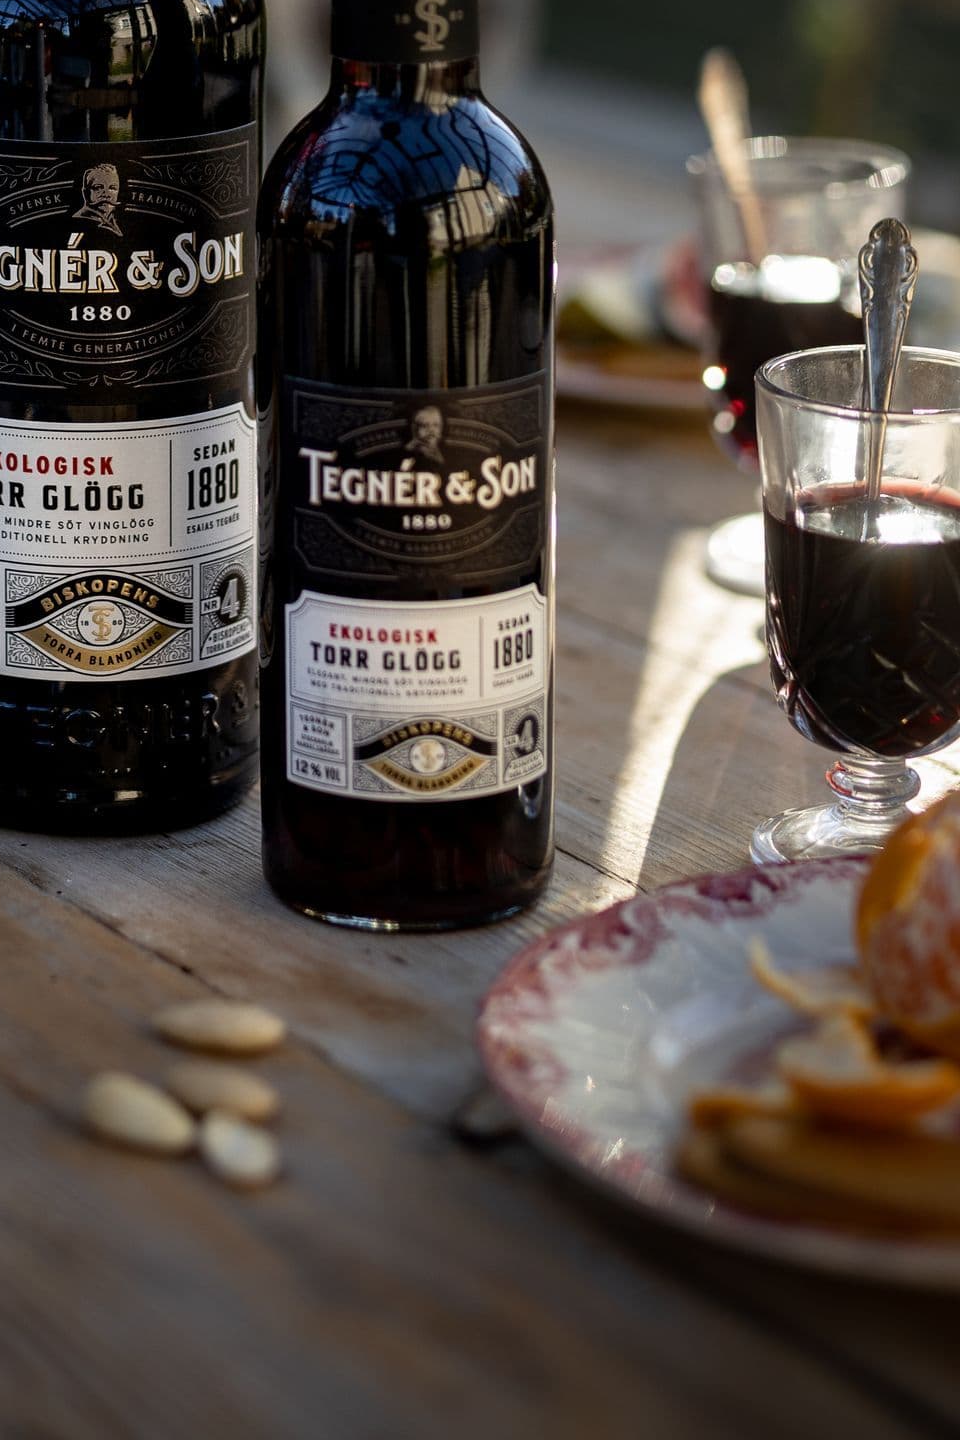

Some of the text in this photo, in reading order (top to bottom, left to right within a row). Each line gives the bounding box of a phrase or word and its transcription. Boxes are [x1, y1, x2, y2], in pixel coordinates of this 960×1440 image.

[9, 193, 63, 215] SVENSK
[127, 249, 164, 290] &
[69, 305, 132, 321] 1880
[22, 329, 65, 351] FEMTE
[73, 321, 186, 354] GENERATIONEN
[193, 438, 235, 461] SEDAN
[187, 458, 239, 511] 1880
[298, 447, 443, 507] TEGNÉR
[445, 469, 476, 504] &
[42, 480, 144, 511] GLÖGG
[4, 516, 51, 529] MINDRE
[89, 518, 155, 530] VINGLÖGG
[186, 521, 214, 534] ESAIAS
[402, 513, 453, 530] 1880
[74, 533, 149, 545] KRYDDNING
[40, 579, 160, 613] BISKOPENS
[204, 577, 240, 618] NR 4
[43, 630, 163, 666] TORRA BLANDNING
[329, 622, 438, 645] EKOLOGISK
[493, 628, 534, 670] 1880
[310, 640, 461, 672] TORR GLÖGG
